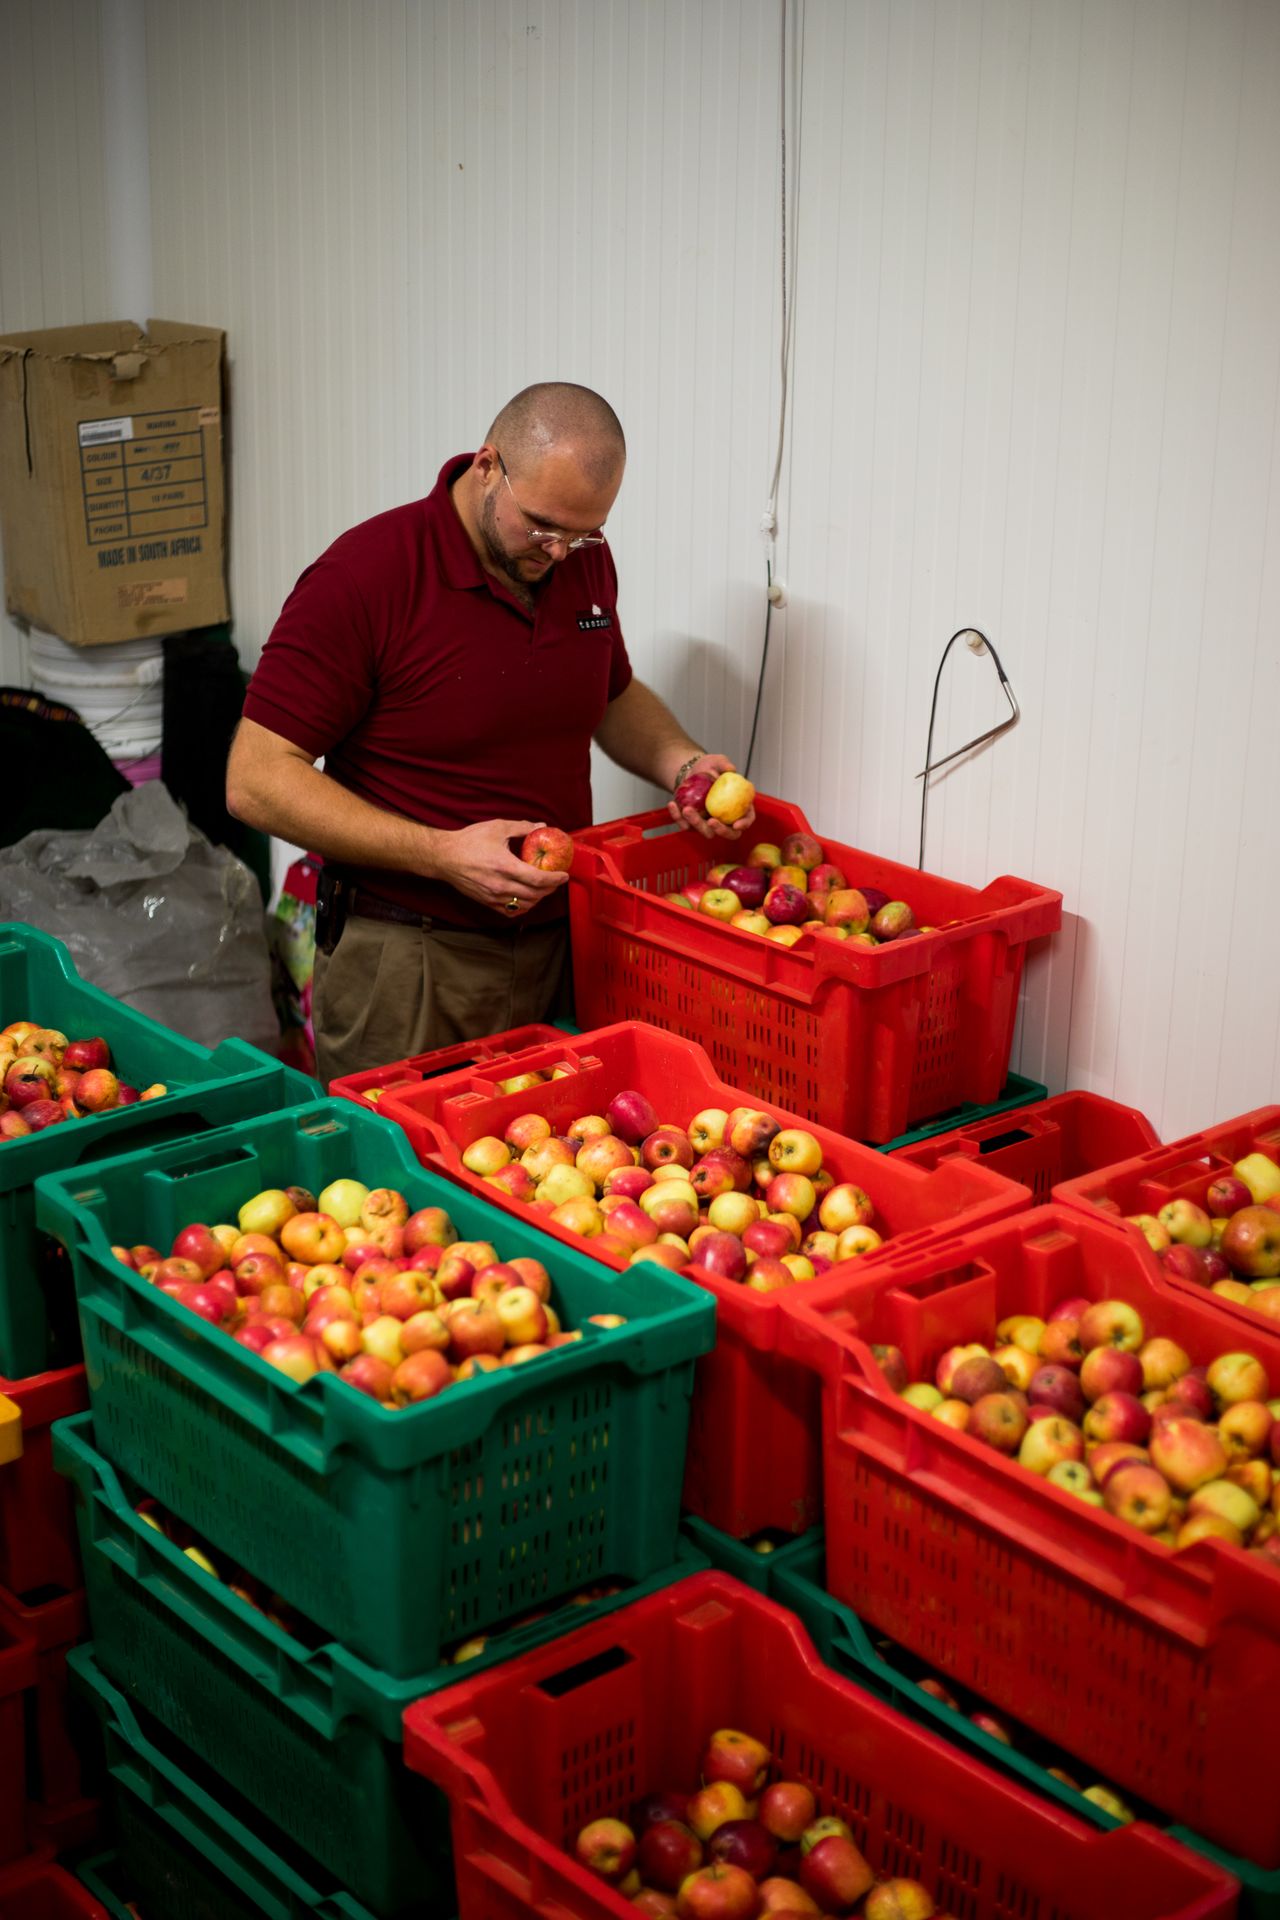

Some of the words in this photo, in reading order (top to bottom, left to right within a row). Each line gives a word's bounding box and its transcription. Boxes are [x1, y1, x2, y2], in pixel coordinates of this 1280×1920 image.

[98, 547, 125, 568] MADE
[126, 546, 137, 564] IN
[139, 541, 168, 562] SOUTH
[170, 536, 202, 556] AFRICA
